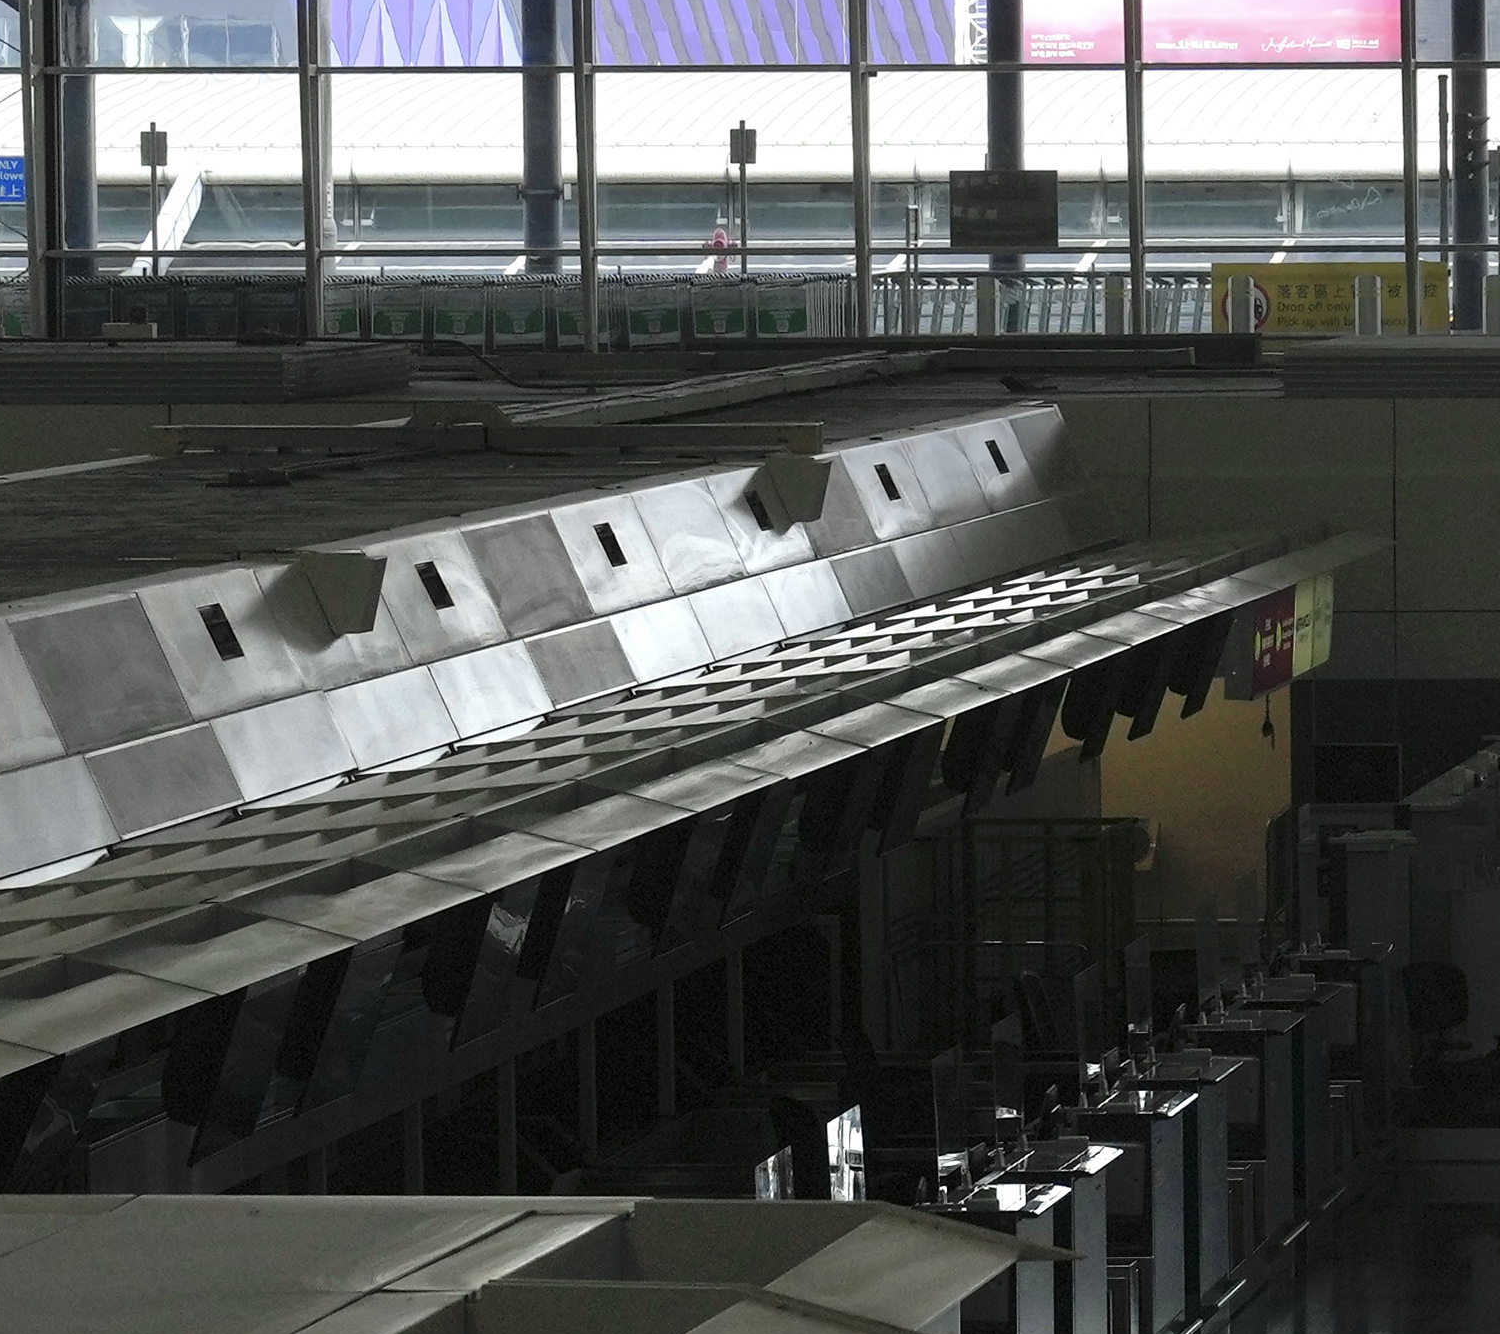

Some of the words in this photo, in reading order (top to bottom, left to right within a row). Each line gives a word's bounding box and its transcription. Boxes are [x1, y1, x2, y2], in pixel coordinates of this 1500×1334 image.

[1277, 301, 1305, 314] Drop
[1308, 301, 1323, 312] off
[1327, 301, 1351, 314] only
